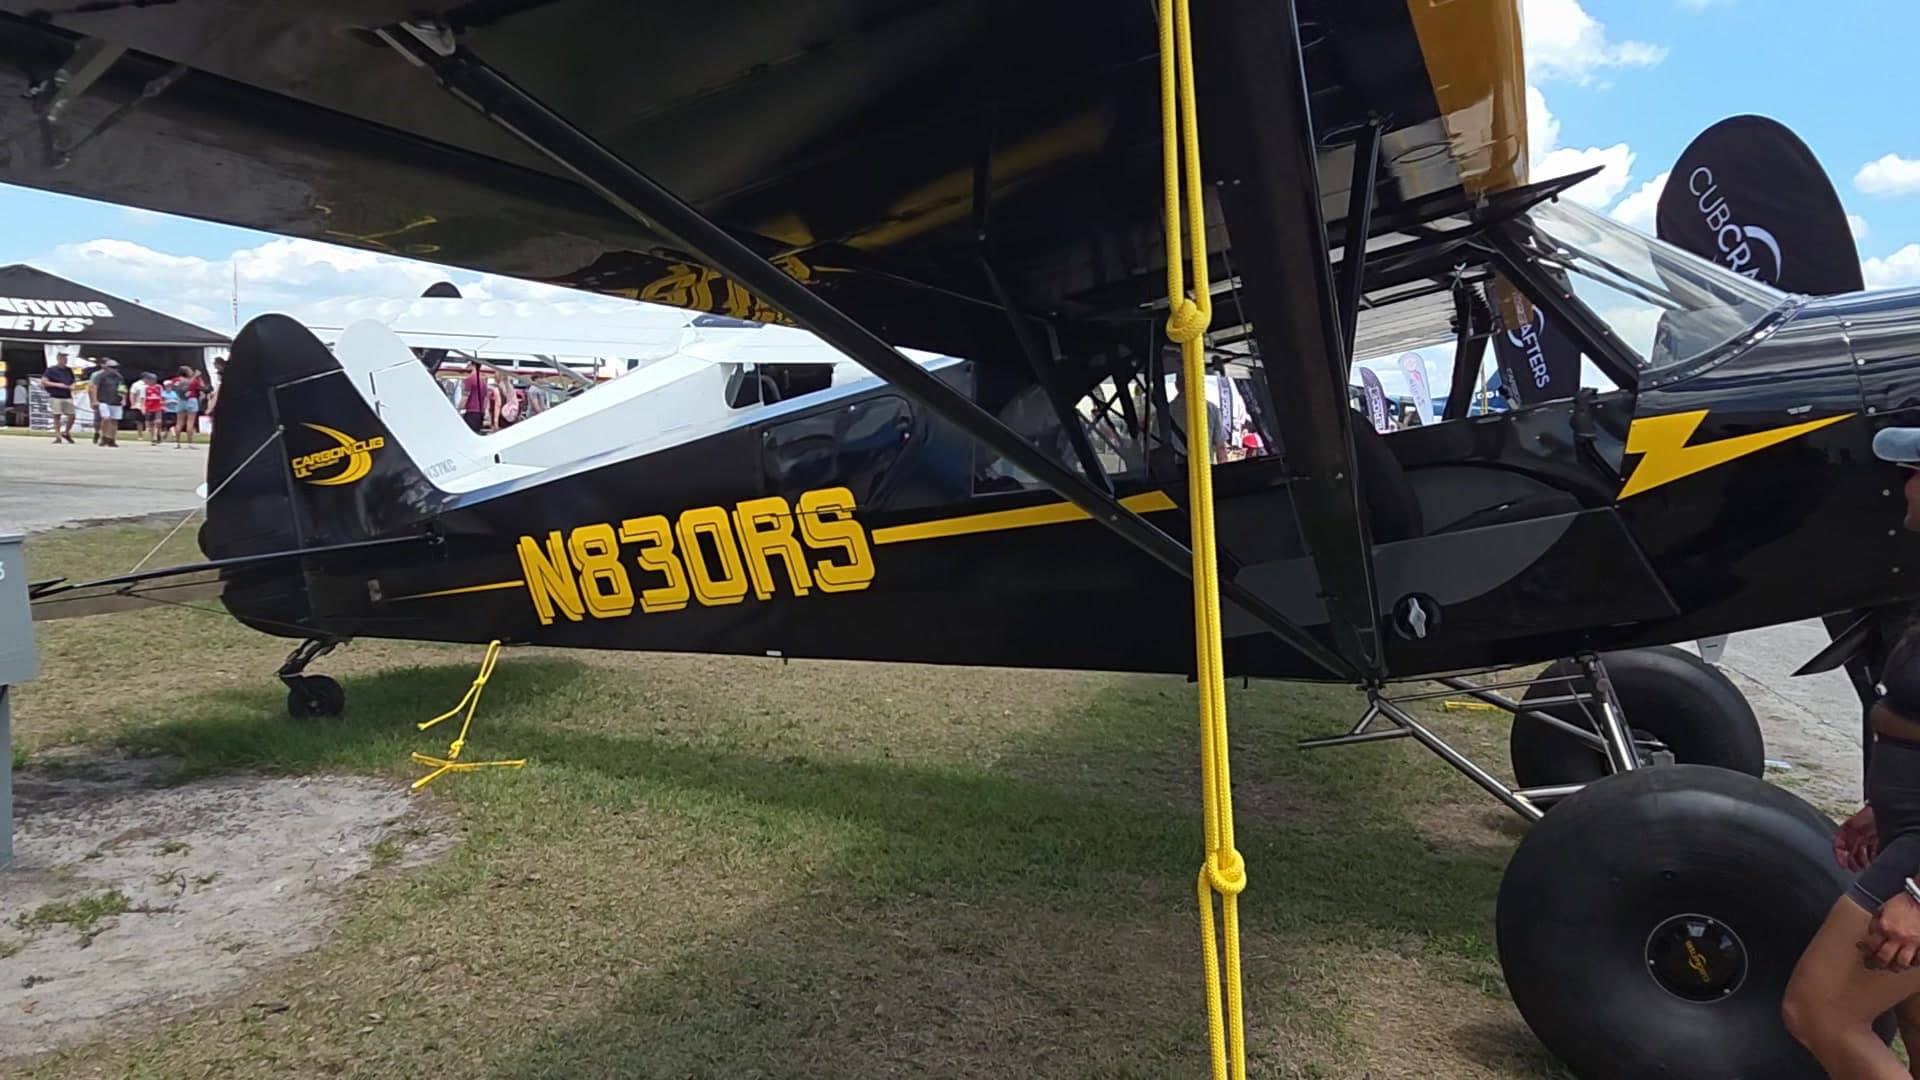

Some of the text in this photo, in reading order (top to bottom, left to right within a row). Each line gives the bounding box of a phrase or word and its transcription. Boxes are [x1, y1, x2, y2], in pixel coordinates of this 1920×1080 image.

[1689, 166, 1763, 281] CUBCRA
[9, 298, 114, 317] FLYING
[292, 446, 352, 468] CARBON
[353, 437, 384, 452] CUB
[516, 487, 875, 625] N830RS
